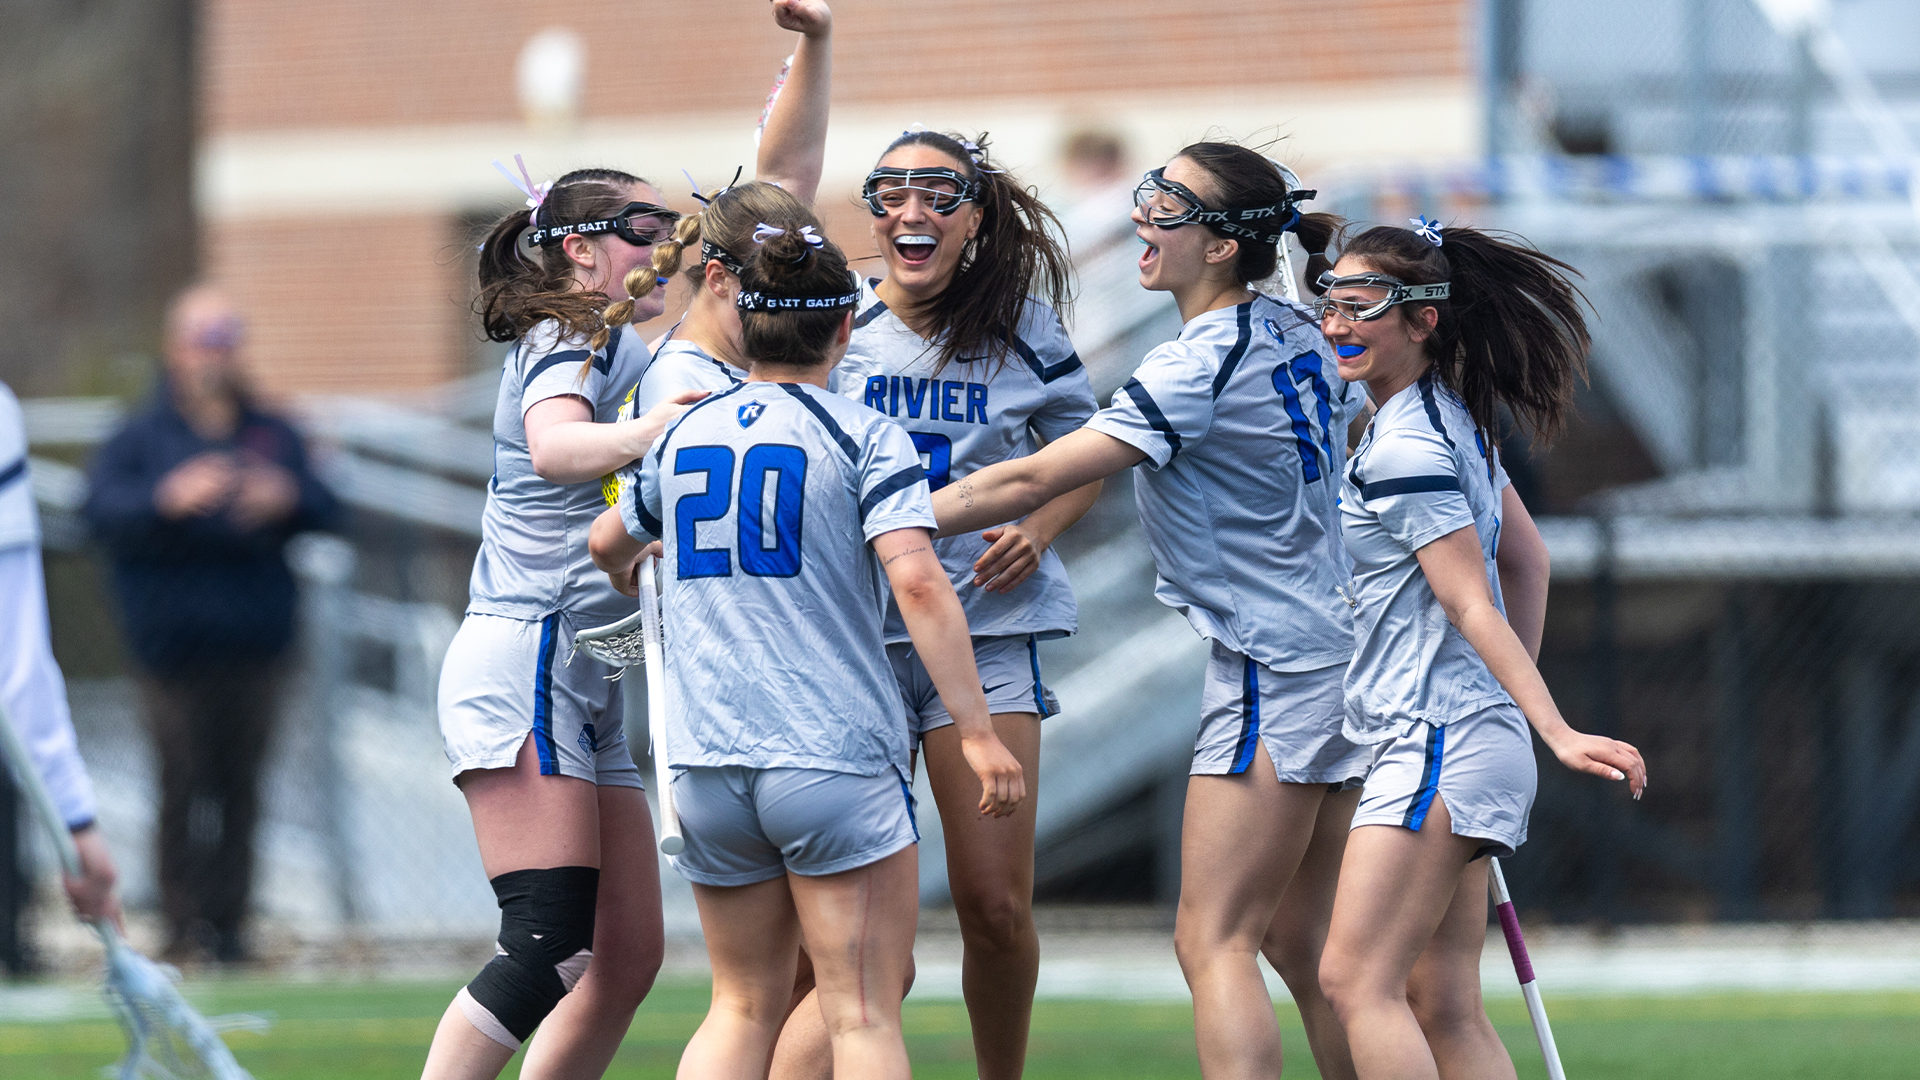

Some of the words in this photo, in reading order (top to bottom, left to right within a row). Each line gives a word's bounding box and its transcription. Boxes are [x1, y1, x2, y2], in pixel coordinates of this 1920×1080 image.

[1241, 206, 1276, 220] STX
[551, 225, 574, 237] GAIT
[578, 221, 608, 232] GAIT
[1221, 222, 1259, 240] STX
[1425, 286, 1447, 297] STX
[806, 298, 836, 308] GAIT
[839, 293, 855, 306] GAIT
[864, 375, 989, 425] RIVIER
[1271, 349, 1333, 485] 17
[674, 443, 808, 580] 20
